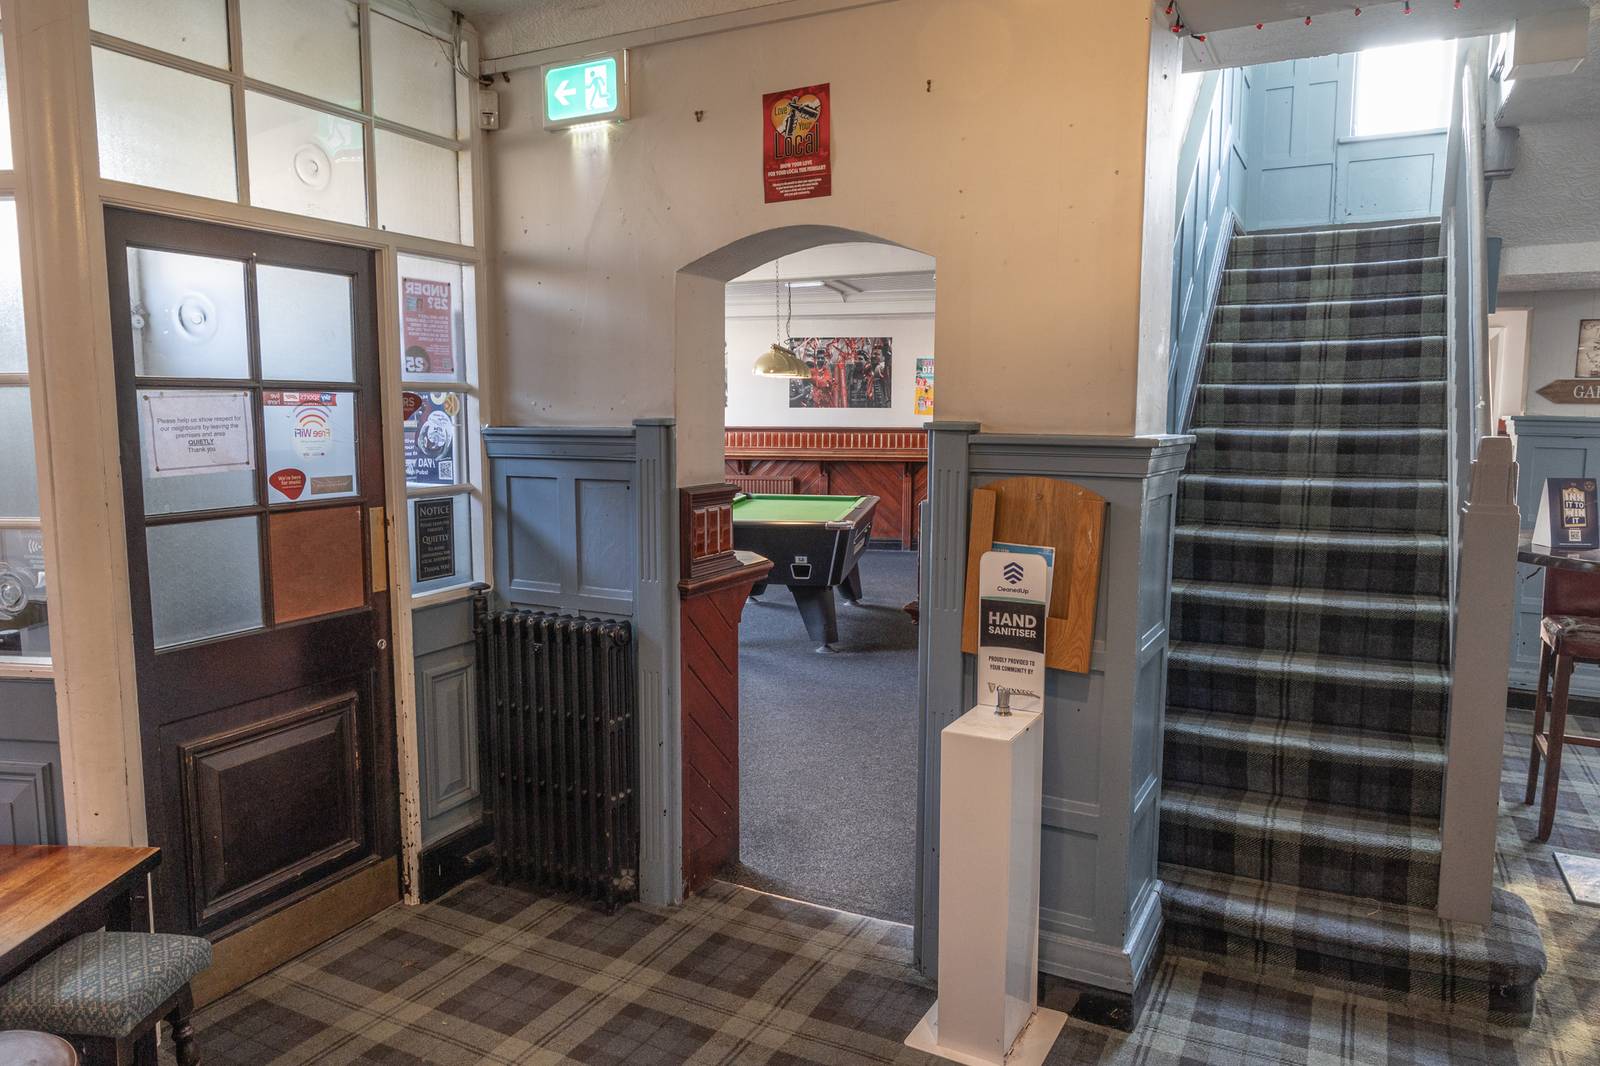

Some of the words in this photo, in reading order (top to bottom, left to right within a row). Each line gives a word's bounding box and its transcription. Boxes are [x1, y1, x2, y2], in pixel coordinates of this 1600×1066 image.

[774, 122, 819, 159] Local
[177, 416, 190, 424] help
[171, 424, 202, 432] neighbours
[188, 438, 215, 446] QUIETLY
[207, 446, 217, 454] you
[420, 505, 449, 517] NOTICE
[997, 586, 1029, 594] CleanedUp
[988, 611, 1037, 628] HAND
[988, 625, 1037, 639] SANITISER
[989, 655, 1007, 663] PROUDLY
[1008, 657, 1029, 666] PROVIDED
[1001, 665, 1027, 674] COMMUNITY
